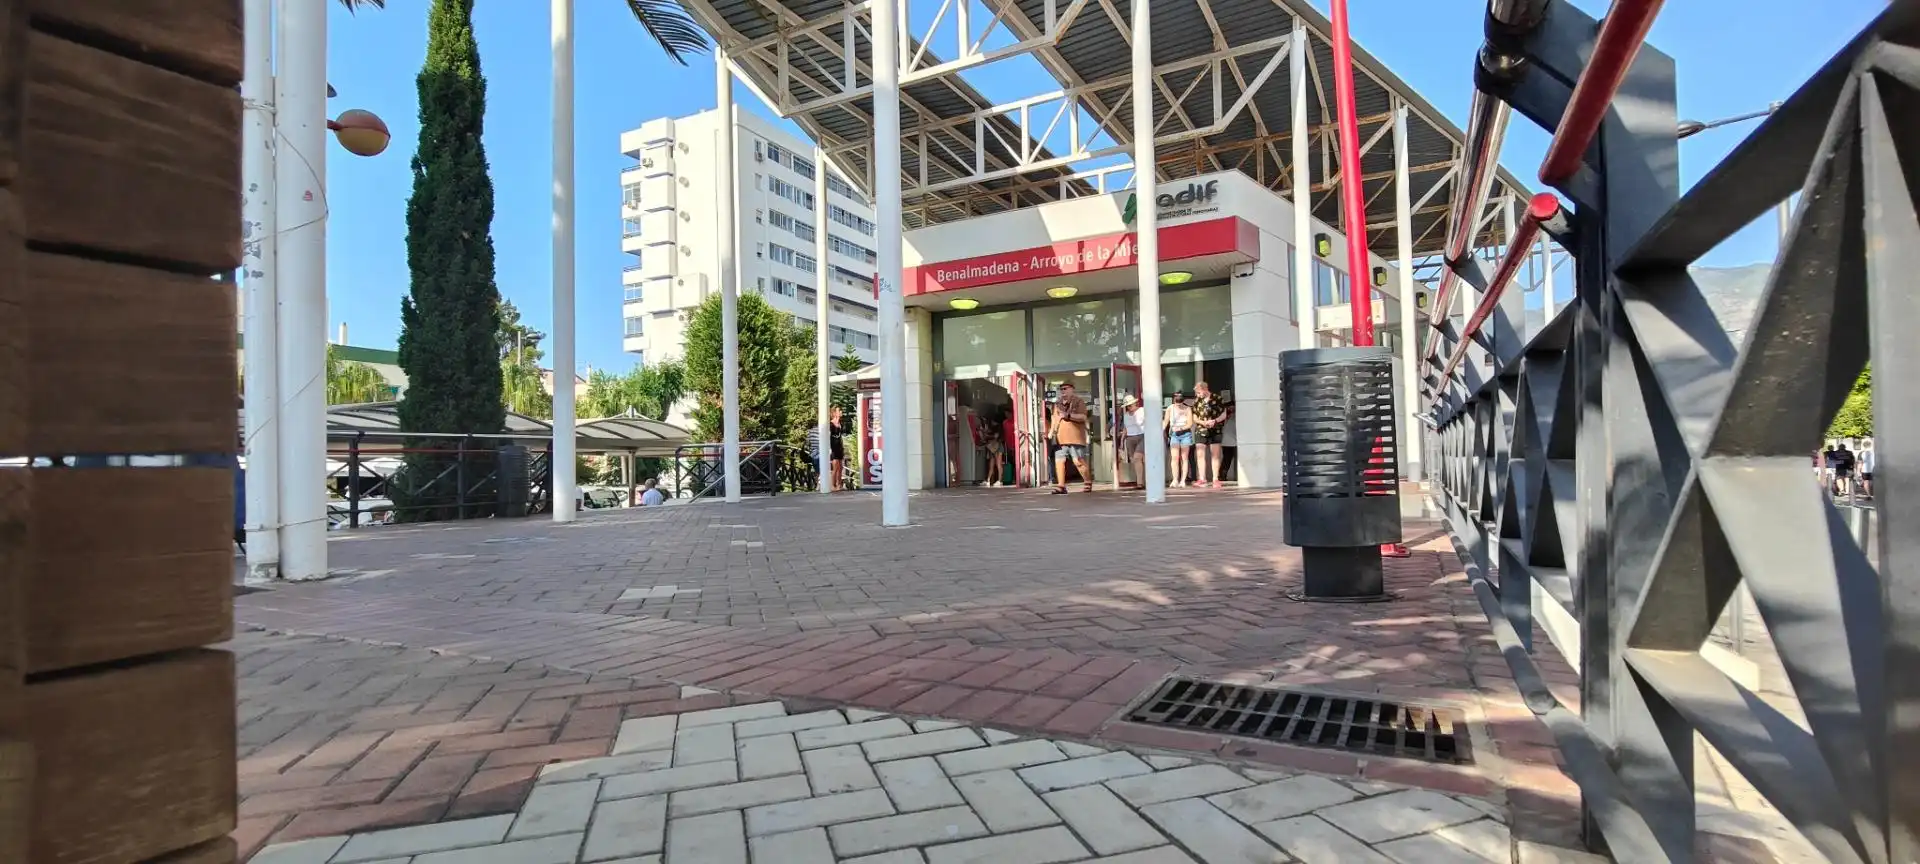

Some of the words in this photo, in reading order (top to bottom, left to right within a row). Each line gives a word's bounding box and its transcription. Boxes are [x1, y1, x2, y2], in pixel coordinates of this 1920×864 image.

[1156, 179, 1218, 207] adif
[937, 260, 1019, 283] Benalmadena
[1030, 254, 1073, 271] Arroyo
[1079, 247, 1093, 262] de
[1097, 244, 1110, 260] la
[1114, 242, 1139, 257] Mie
